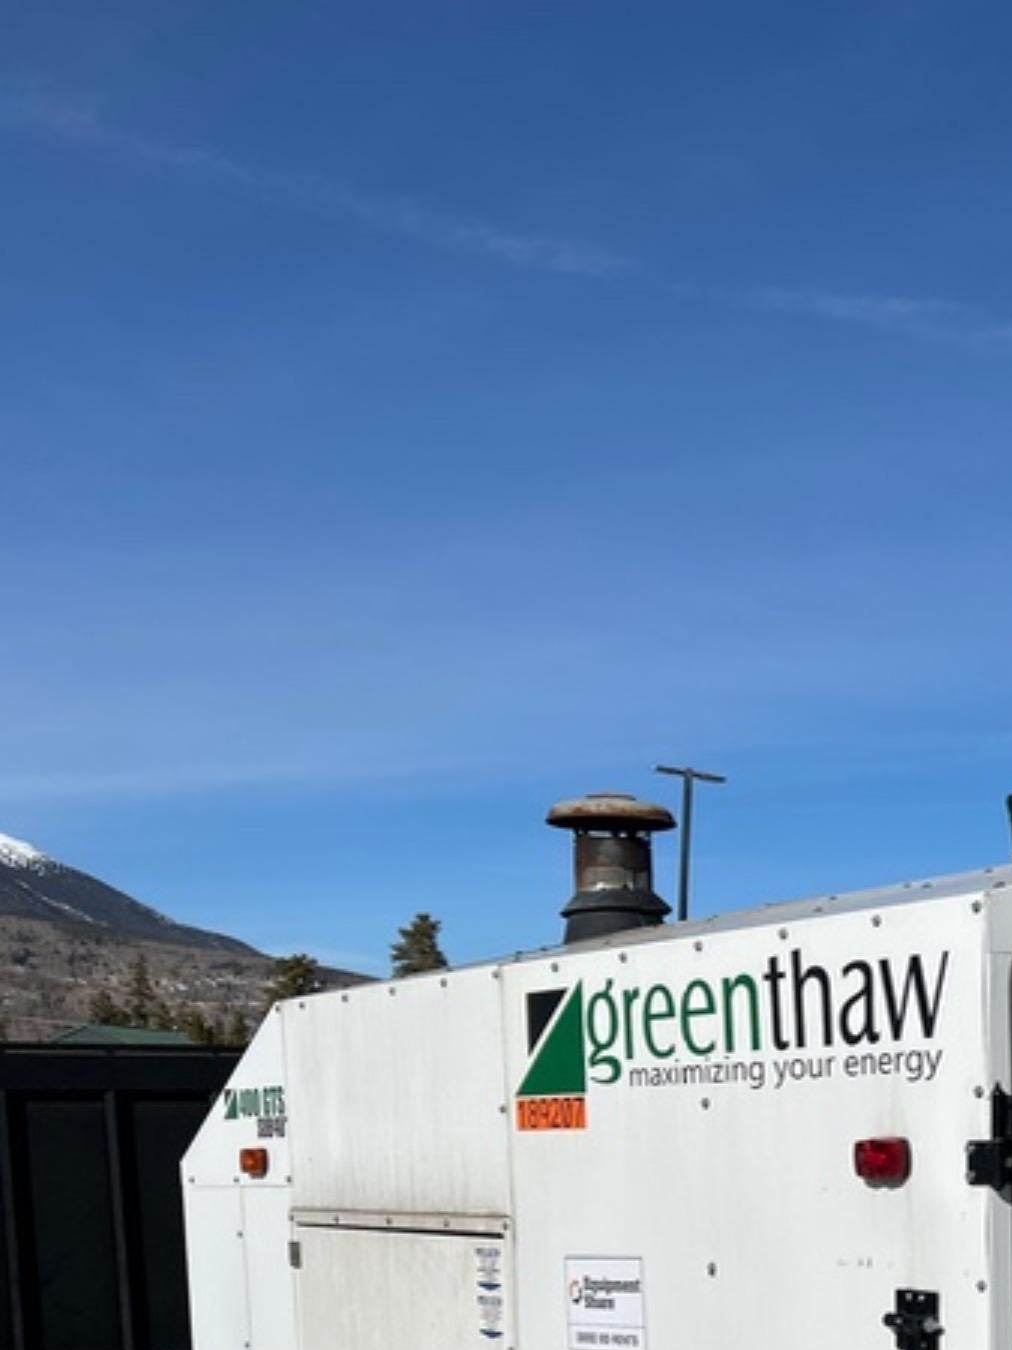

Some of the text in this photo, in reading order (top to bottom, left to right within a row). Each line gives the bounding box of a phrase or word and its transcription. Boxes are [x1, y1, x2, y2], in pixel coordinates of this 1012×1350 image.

[587, 948, 949, 1084] greenthaw
[629, 1049, 943, 1089] maximizing your energy
